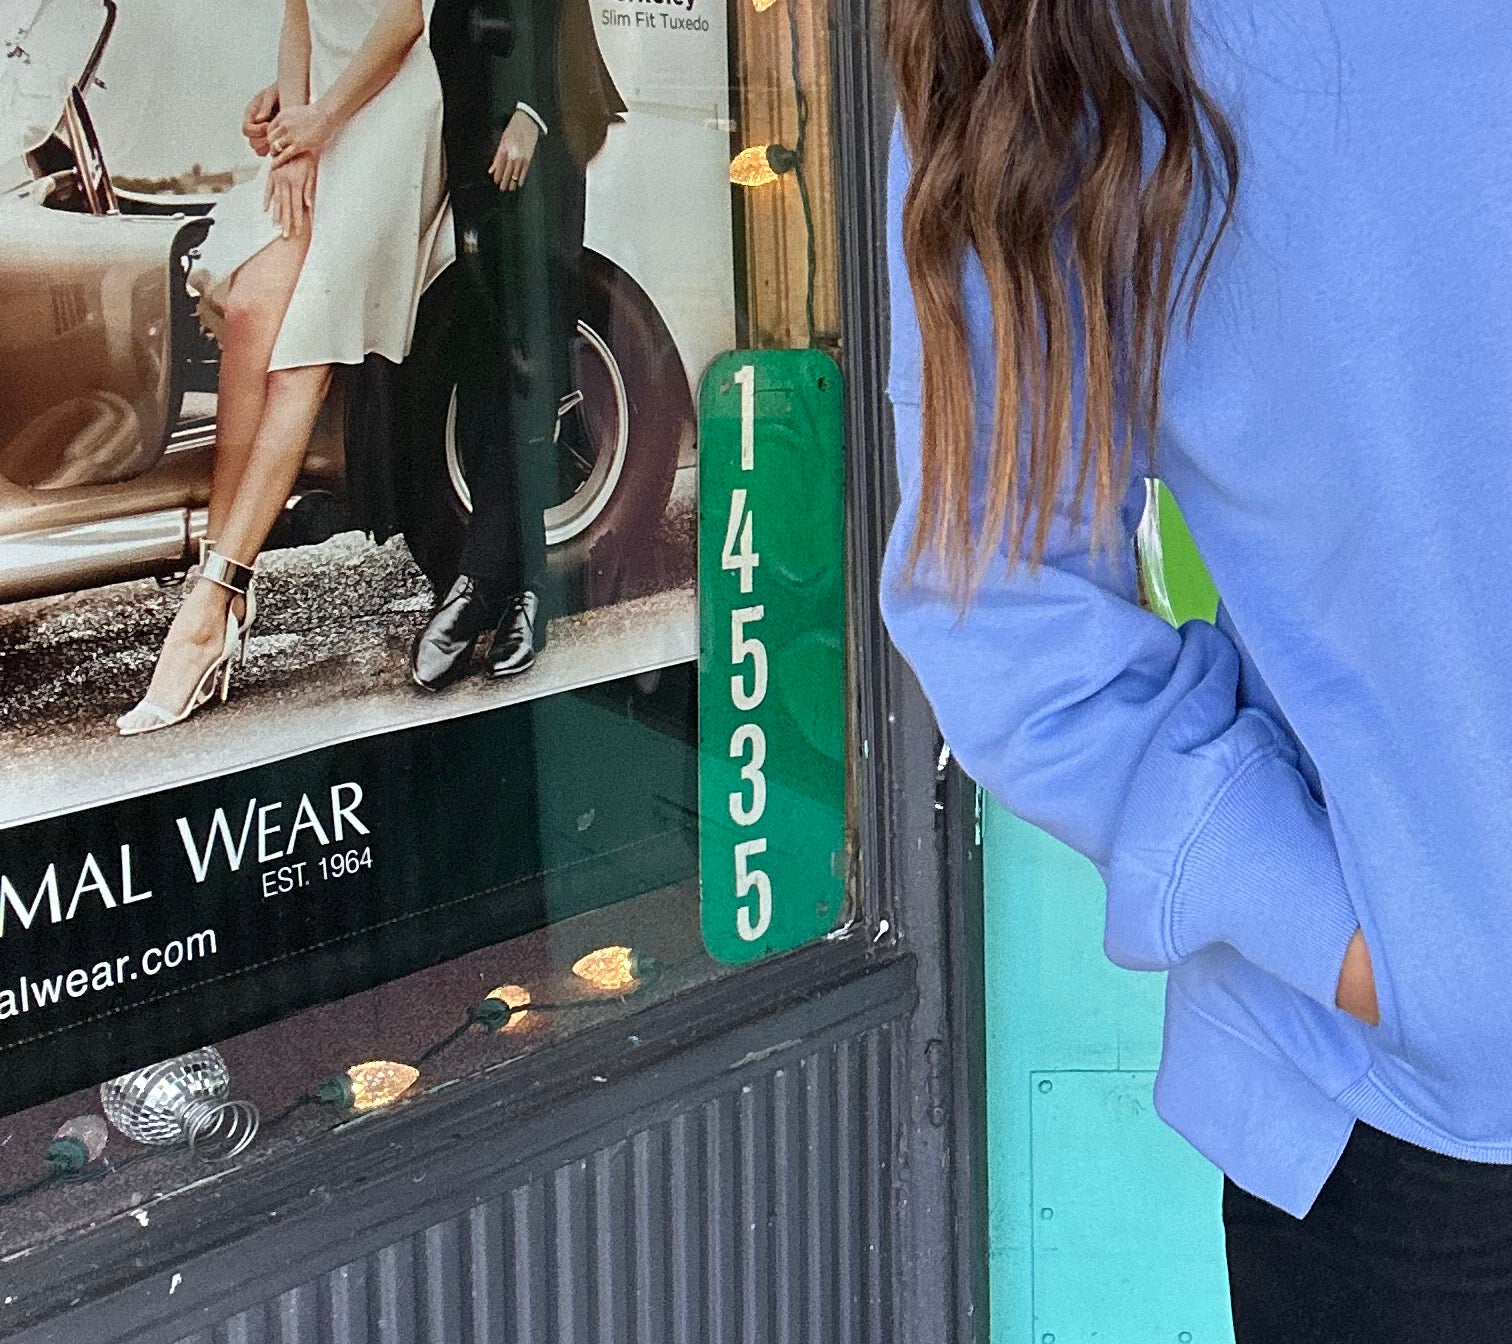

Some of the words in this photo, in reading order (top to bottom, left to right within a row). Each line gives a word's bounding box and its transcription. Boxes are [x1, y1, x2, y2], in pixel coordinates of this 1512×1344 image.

[602, 9, 631, 26] Slim
[635, 11, 656, 29] Fit
[659, 13, 710, 32] Tuxedo
[722, 365, 772, 940] 14535
[176, 782, 370, 883] WEAR
[262, 862, 310, 898] EST.
[319, 847, 373, 881] 1964
